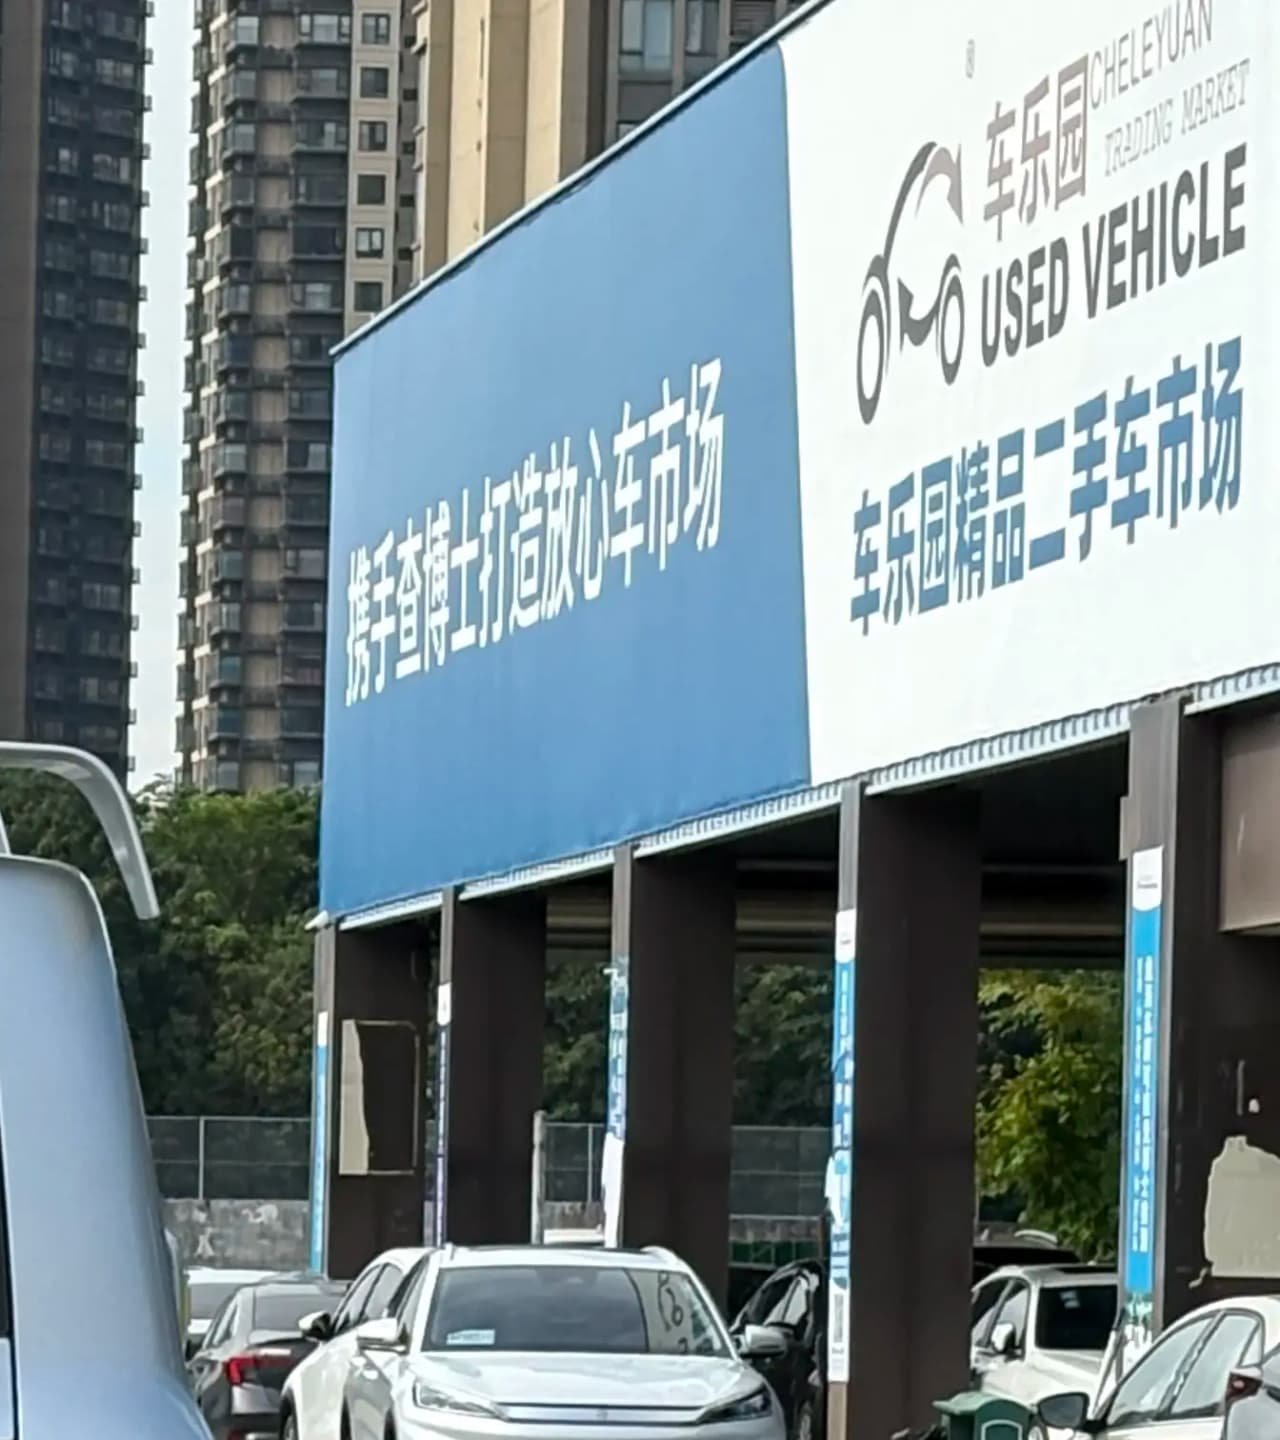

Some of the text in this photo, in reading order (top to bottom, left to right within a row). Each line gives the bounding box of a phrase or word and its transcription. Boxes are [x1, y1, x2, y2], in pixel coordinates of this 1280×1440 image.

[982, 52, 1090, 242] 车乐园
[1090, 0, 1214, 110] CHELEYUAN
[1104, 57, 1251, 178] TRADING MARKET
[980, 142, 1248, 368] USED VEHICLE
[345, 357, 724, 708] 携手查博士打造放心车市场
[850, 335, 1244, 637] 车乐园精品二手车市场
